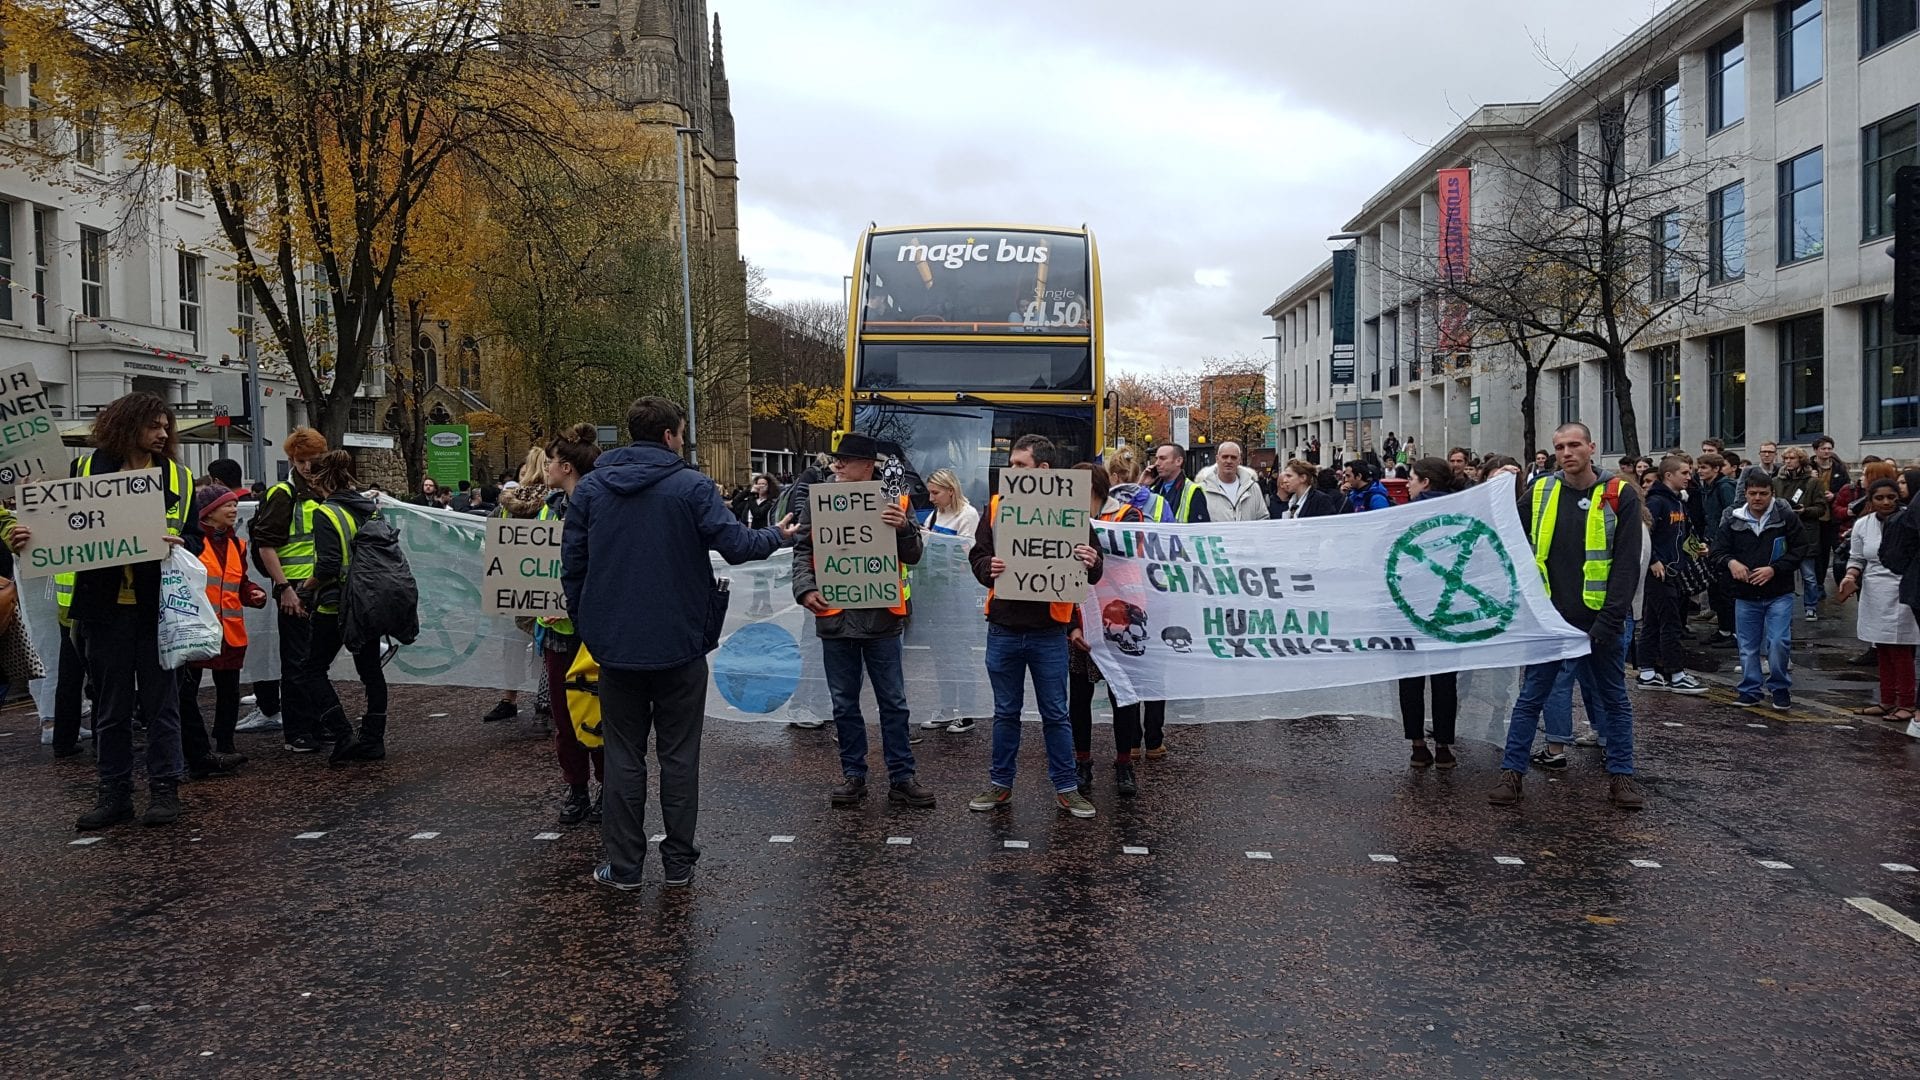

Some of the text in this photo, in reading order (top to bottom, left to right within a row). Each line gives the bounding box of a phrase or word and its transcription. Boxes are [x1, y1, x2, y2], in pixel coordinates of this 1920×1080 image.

[897, 238, 1048, 269] magic bus
[1033, 288, 1075, 300] Single
[1024, 301, 1082, 328] £1.50
[0, 416, 50, 446] EDS
[22, 474, 163, 506] EXTINCTION
[1005, 475, 1073, 497] YOUR
[818, 493, 877, 511] HOPE
[68, 510, 105, 531] OR
[1001, 506, 1089, 527] PLANET
[820, 525, 873, 545] DIES
[1095, 527, 1229, 565] CLIMATE
[32, 536, 147, 568] SURVIVAL
[487, 556, 503, 577] A
[824, 555, 897, 575] ACTION
[1146, 562, 1283, 599] CHANGE
[822, 583, 897, 602] BEGINS
[1203, 607, 1329, 636] HUMAN
